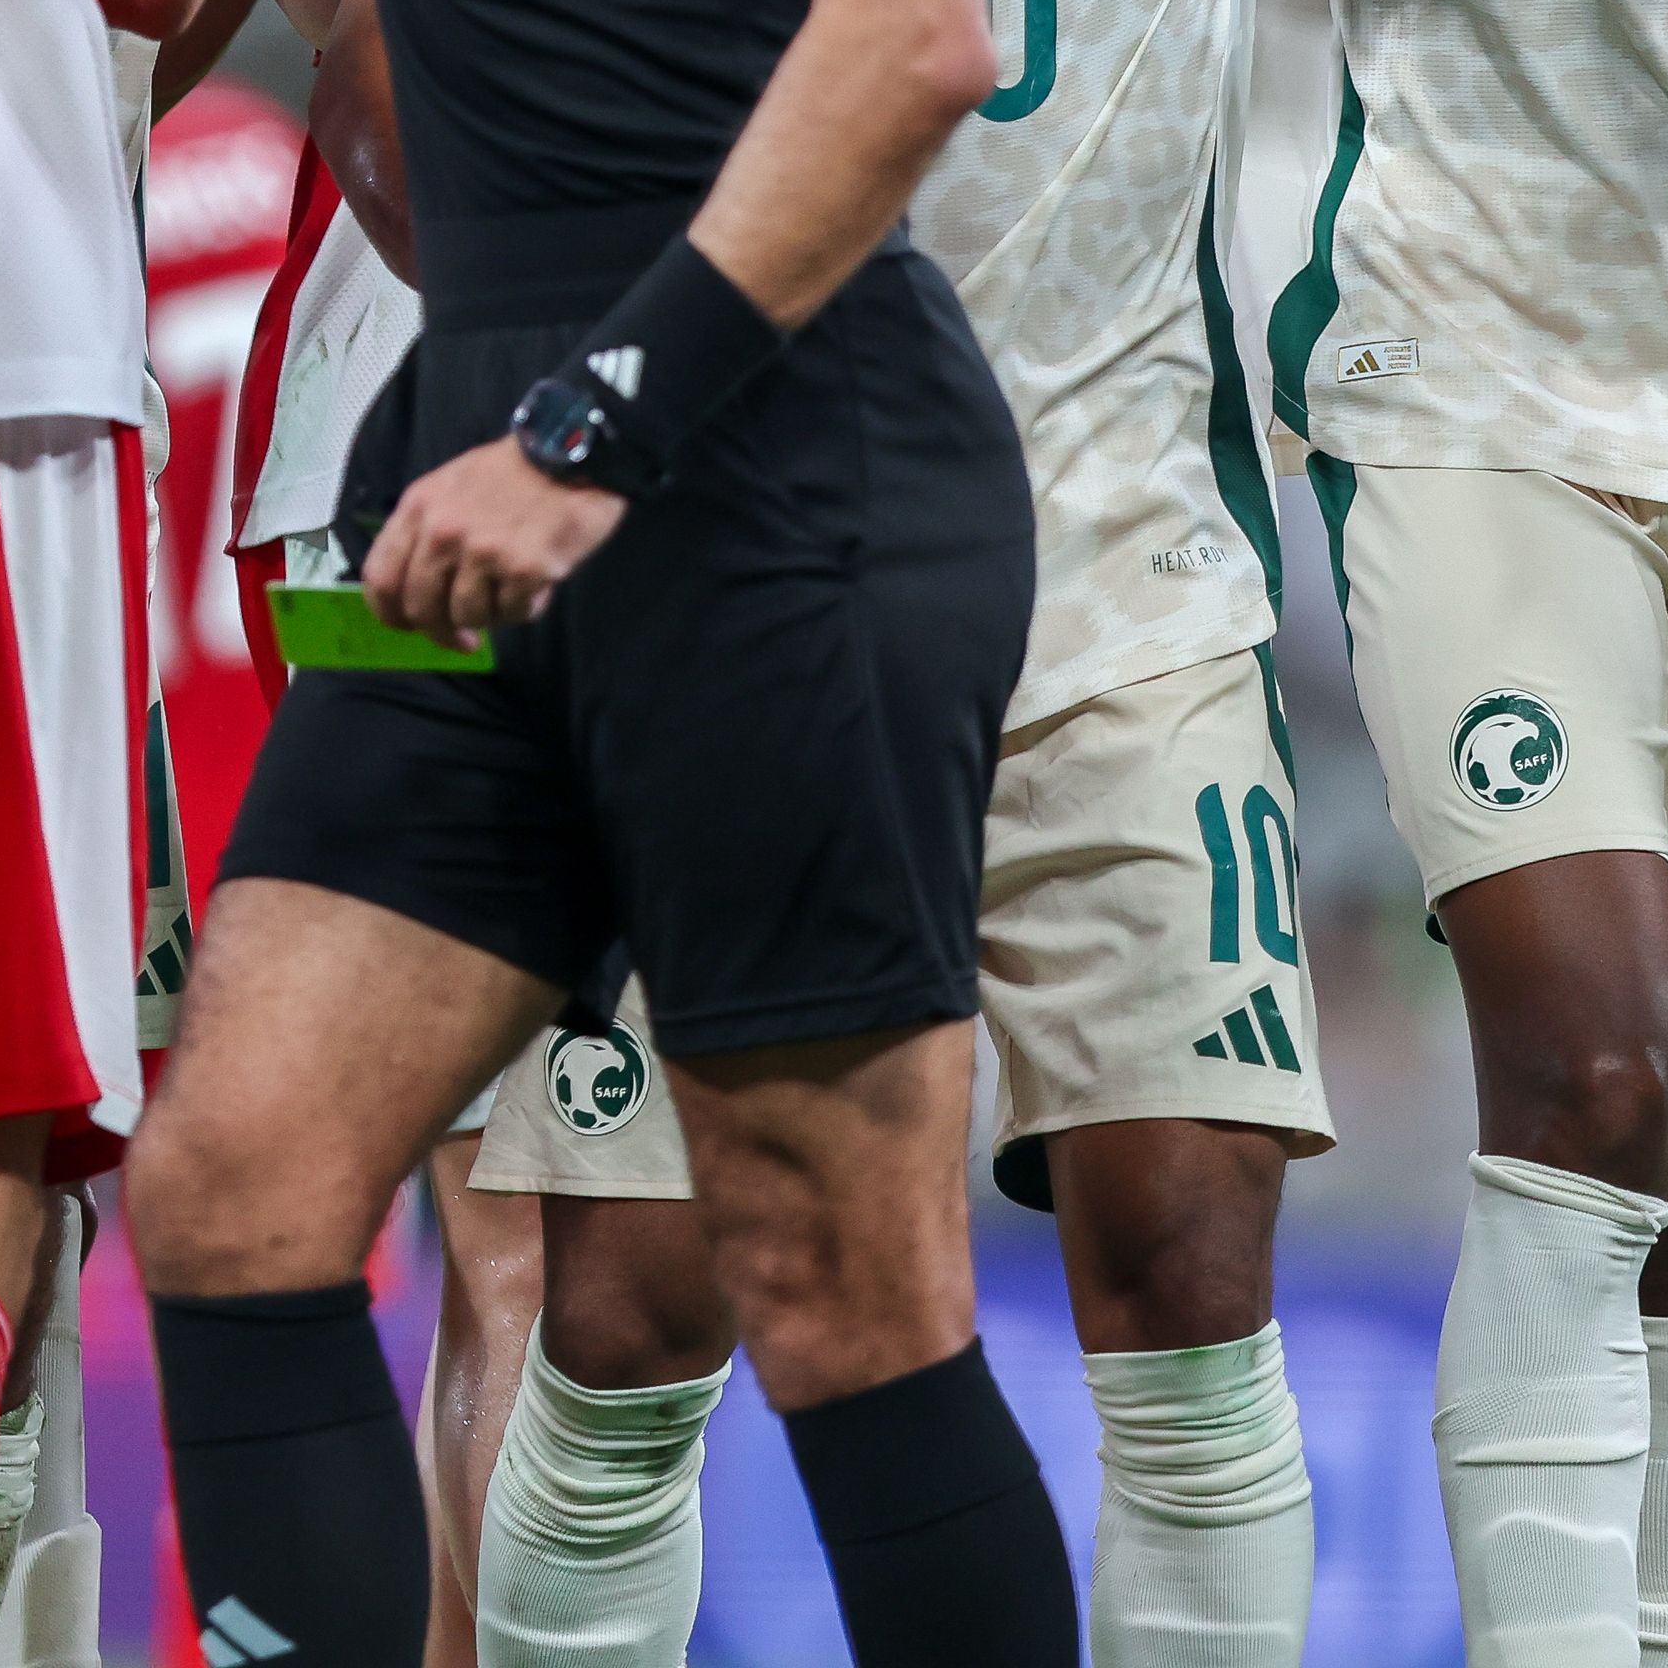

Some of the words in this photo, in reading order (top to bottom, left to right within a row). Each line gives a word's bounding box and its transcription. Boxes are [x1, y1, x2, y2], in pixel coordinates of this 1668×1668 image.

[1151, 545, 1229, 574] HEAT.RDY
[1515, 753, 1549, 772] SAFF
[1195, 782, 1299, 969] 10
[594, 1086, 627, 1098] SAFF
